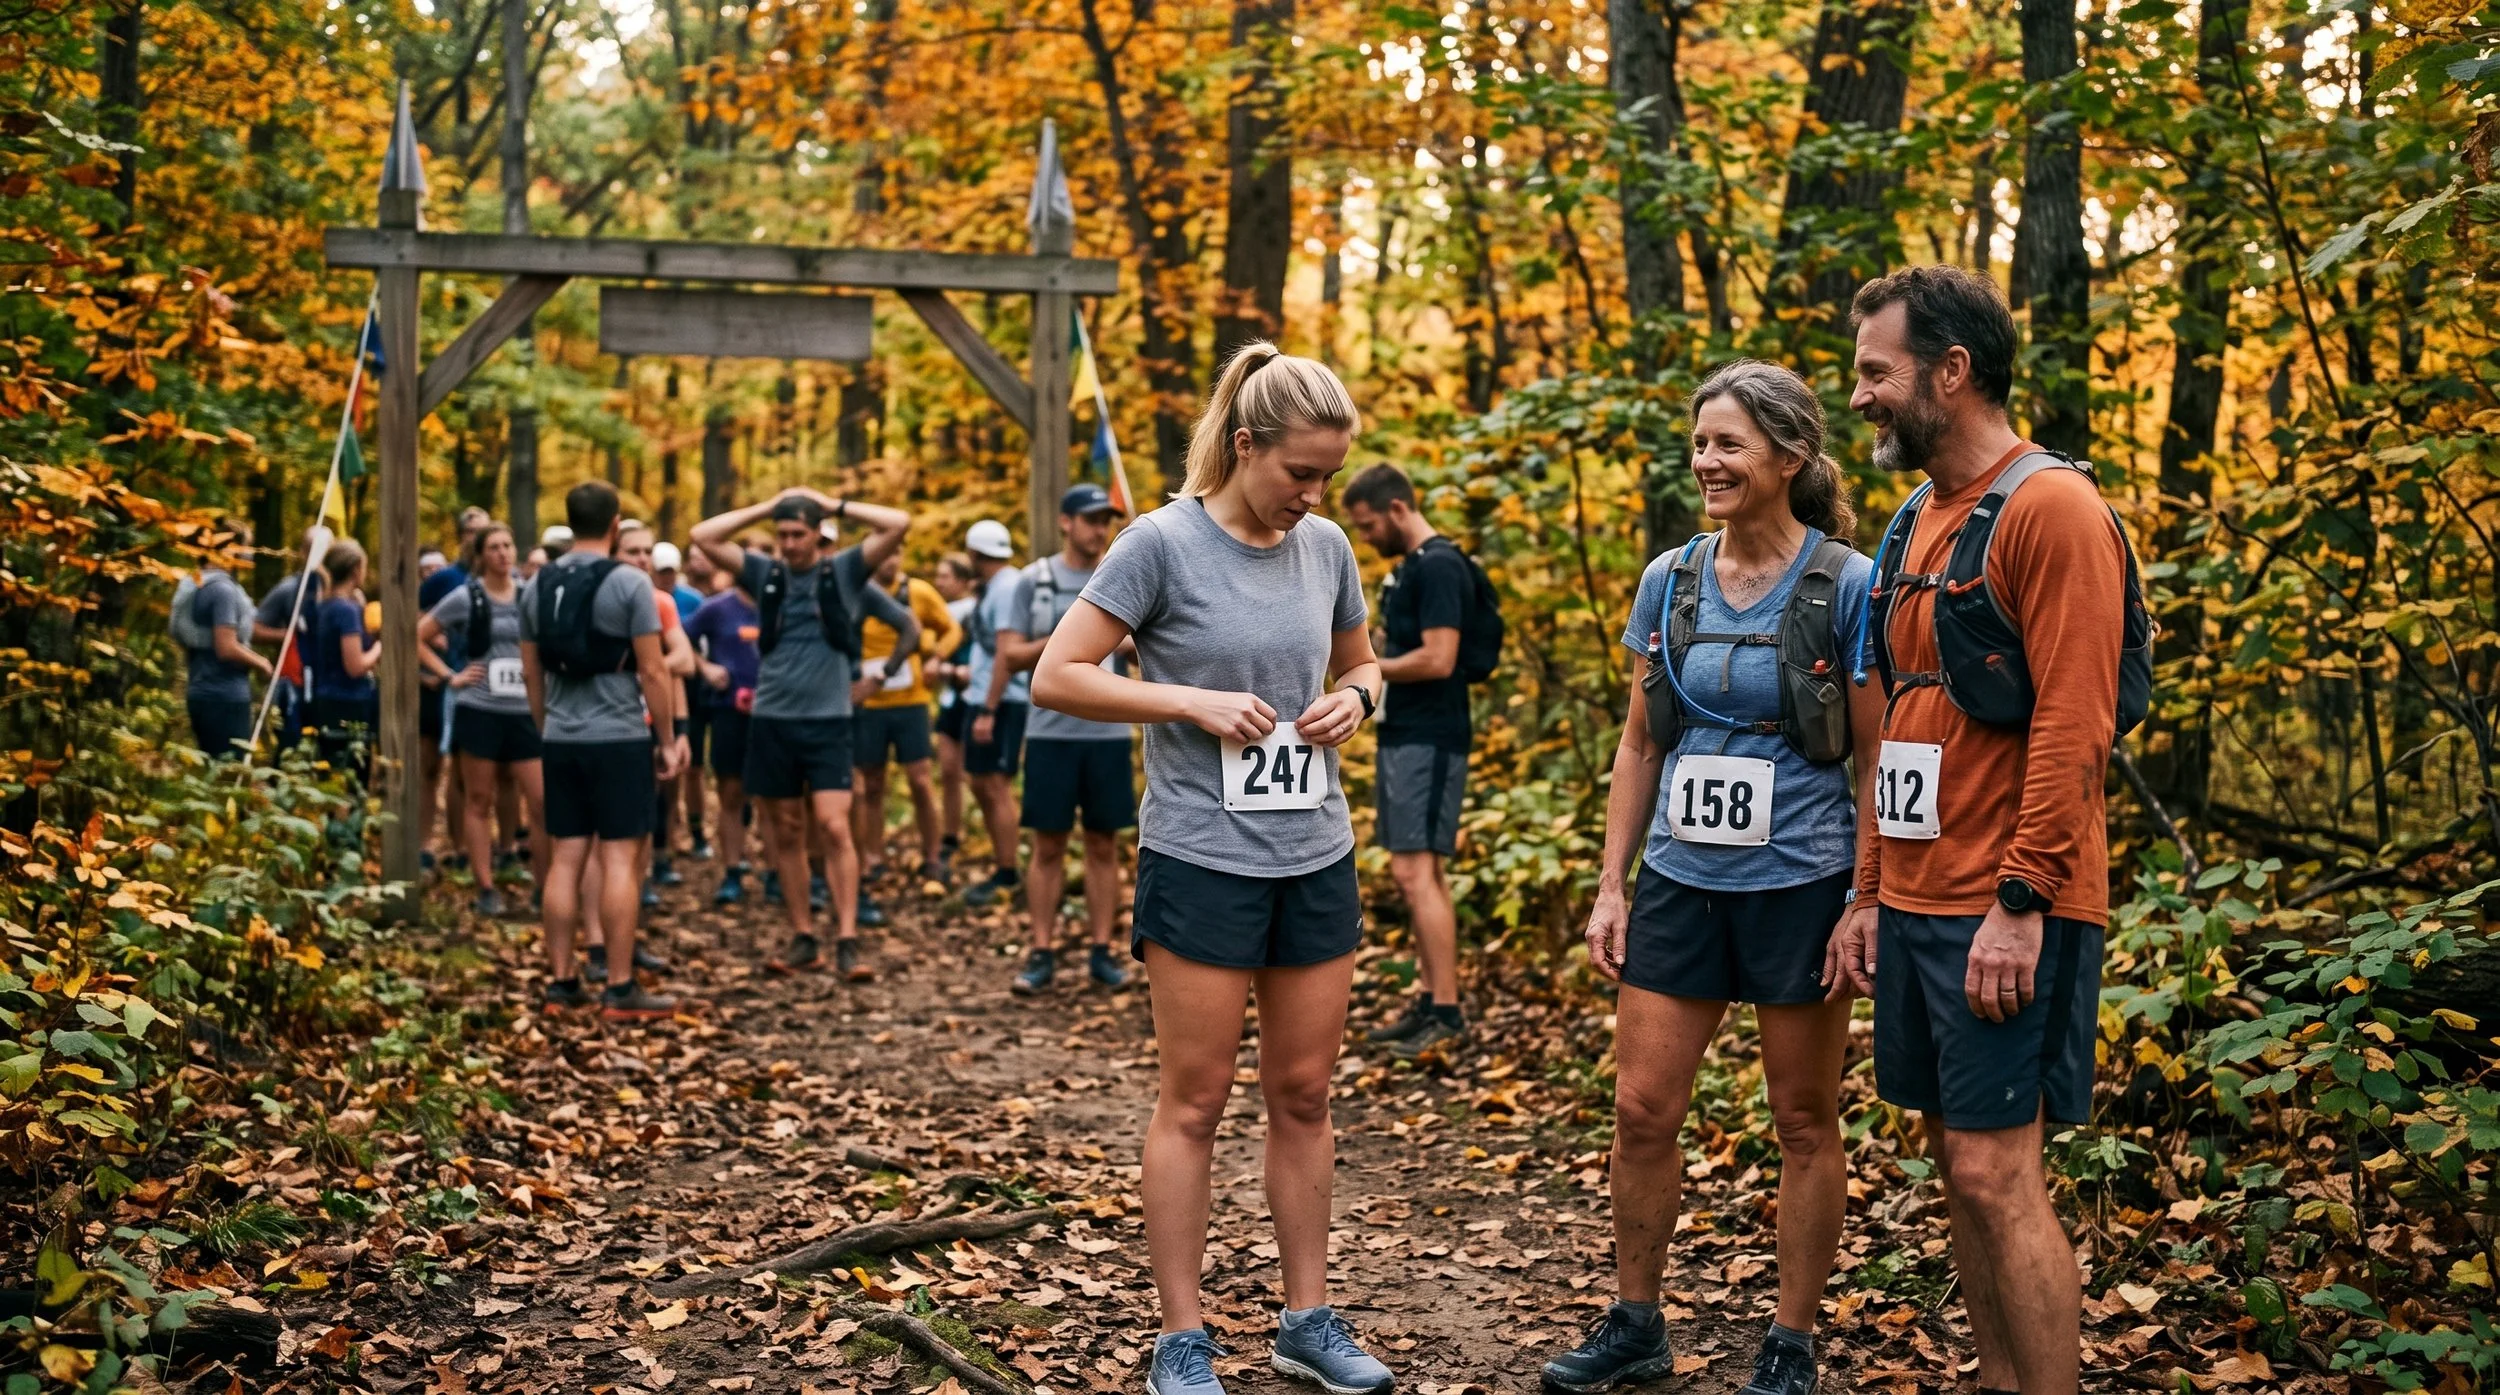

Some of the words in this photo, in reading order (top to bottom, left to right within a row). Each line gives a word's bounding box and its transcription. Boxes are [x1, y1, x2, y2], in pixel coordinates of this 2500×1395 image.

[1241, 745, 1314, 795] 247
[1876, 766, 1924, 824] 312
[1681, 778, 1753, 831] 158
